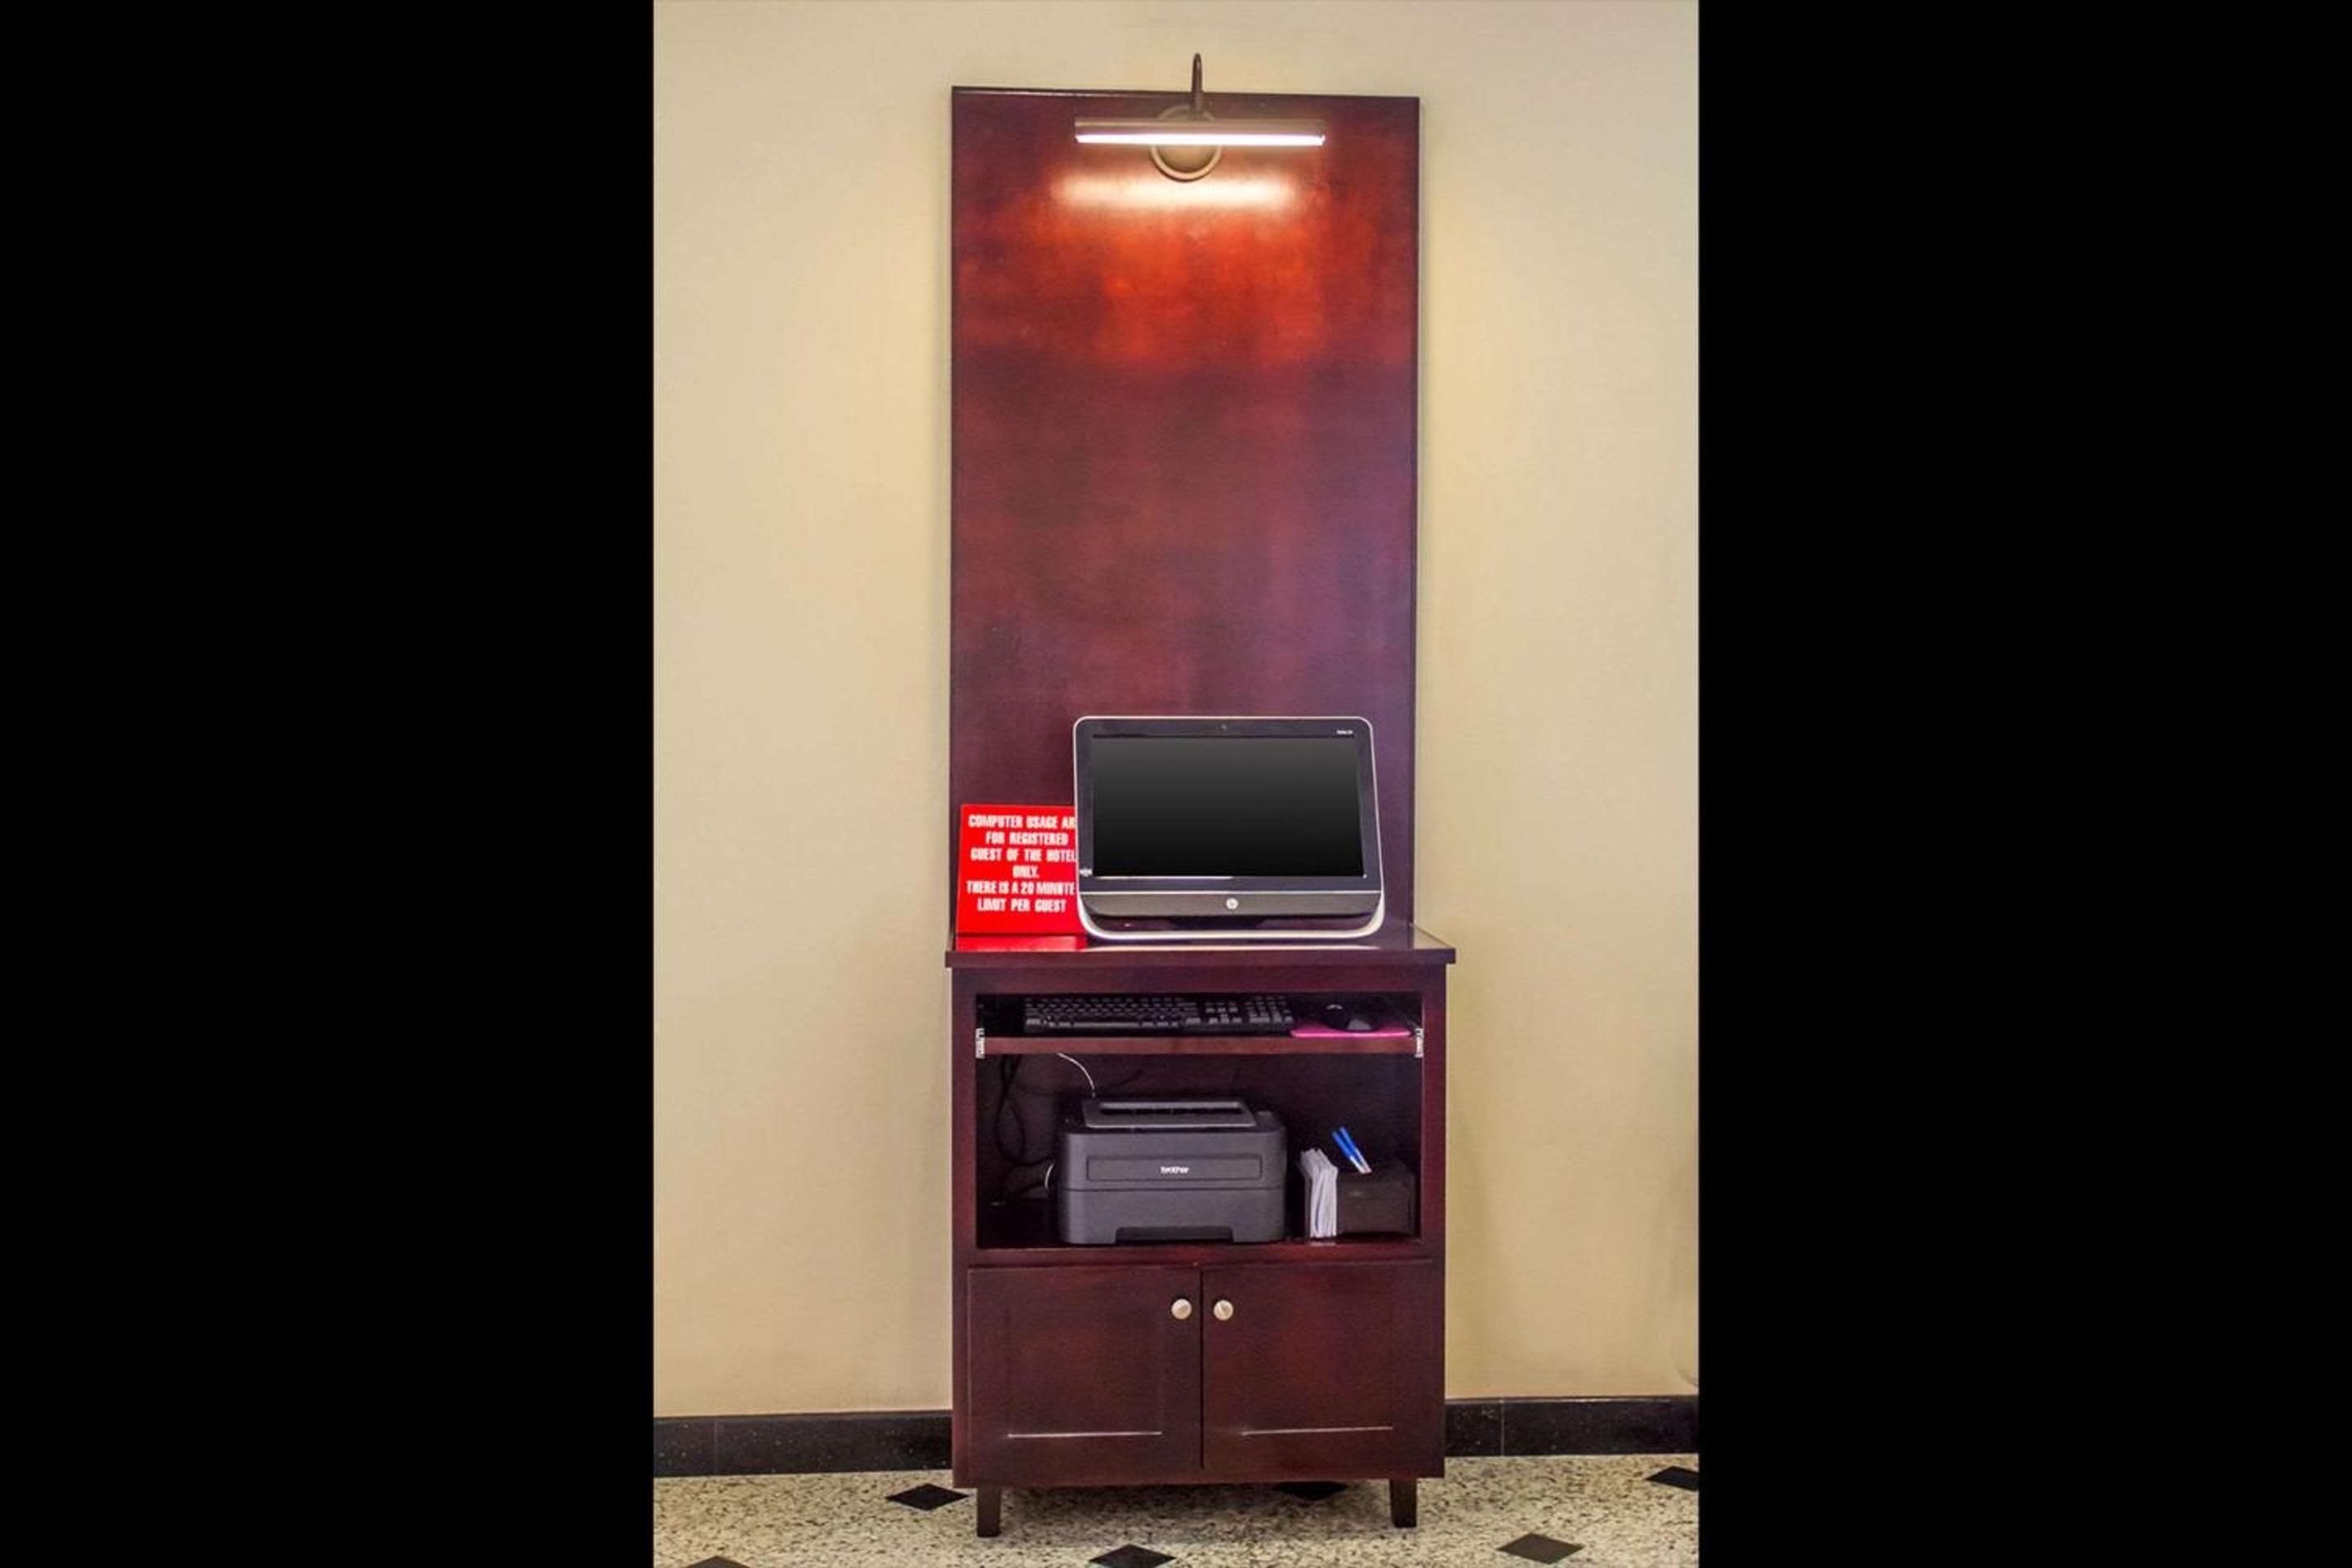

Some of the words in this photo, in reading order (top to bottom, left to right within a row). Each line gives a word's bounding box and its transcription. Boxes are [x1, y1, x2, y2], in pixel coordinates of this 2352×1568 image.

[968, 814, 1022, 828] COMPUTER
[1026, 816, 1058, 829] USAGE
[1061, 817, 1076, 830] AR
[985, 831, 1005, 844] FOR
[1009, 832, 1069, 846] REGISTERED
[969, 847, 1002, 862] GUEST
[1005, 848, 1019, 862] OF
[1024, 849, 1043, 862] THE
[1012, 864, 1040, 879] ONLY.
[966, 880, 997, 895] THERE
[998, 881, 1009, 895] IS
[1011, 881, 1018, 895] A
[1020, 882, 1035, 895] 20
[1036, 882, 1076, 896] MINUTE
[977, 898, 1007, 911] LIMIT
[1010, 898, 1031, 912] PER
[1034, 899, 1067, 913] GUEST
